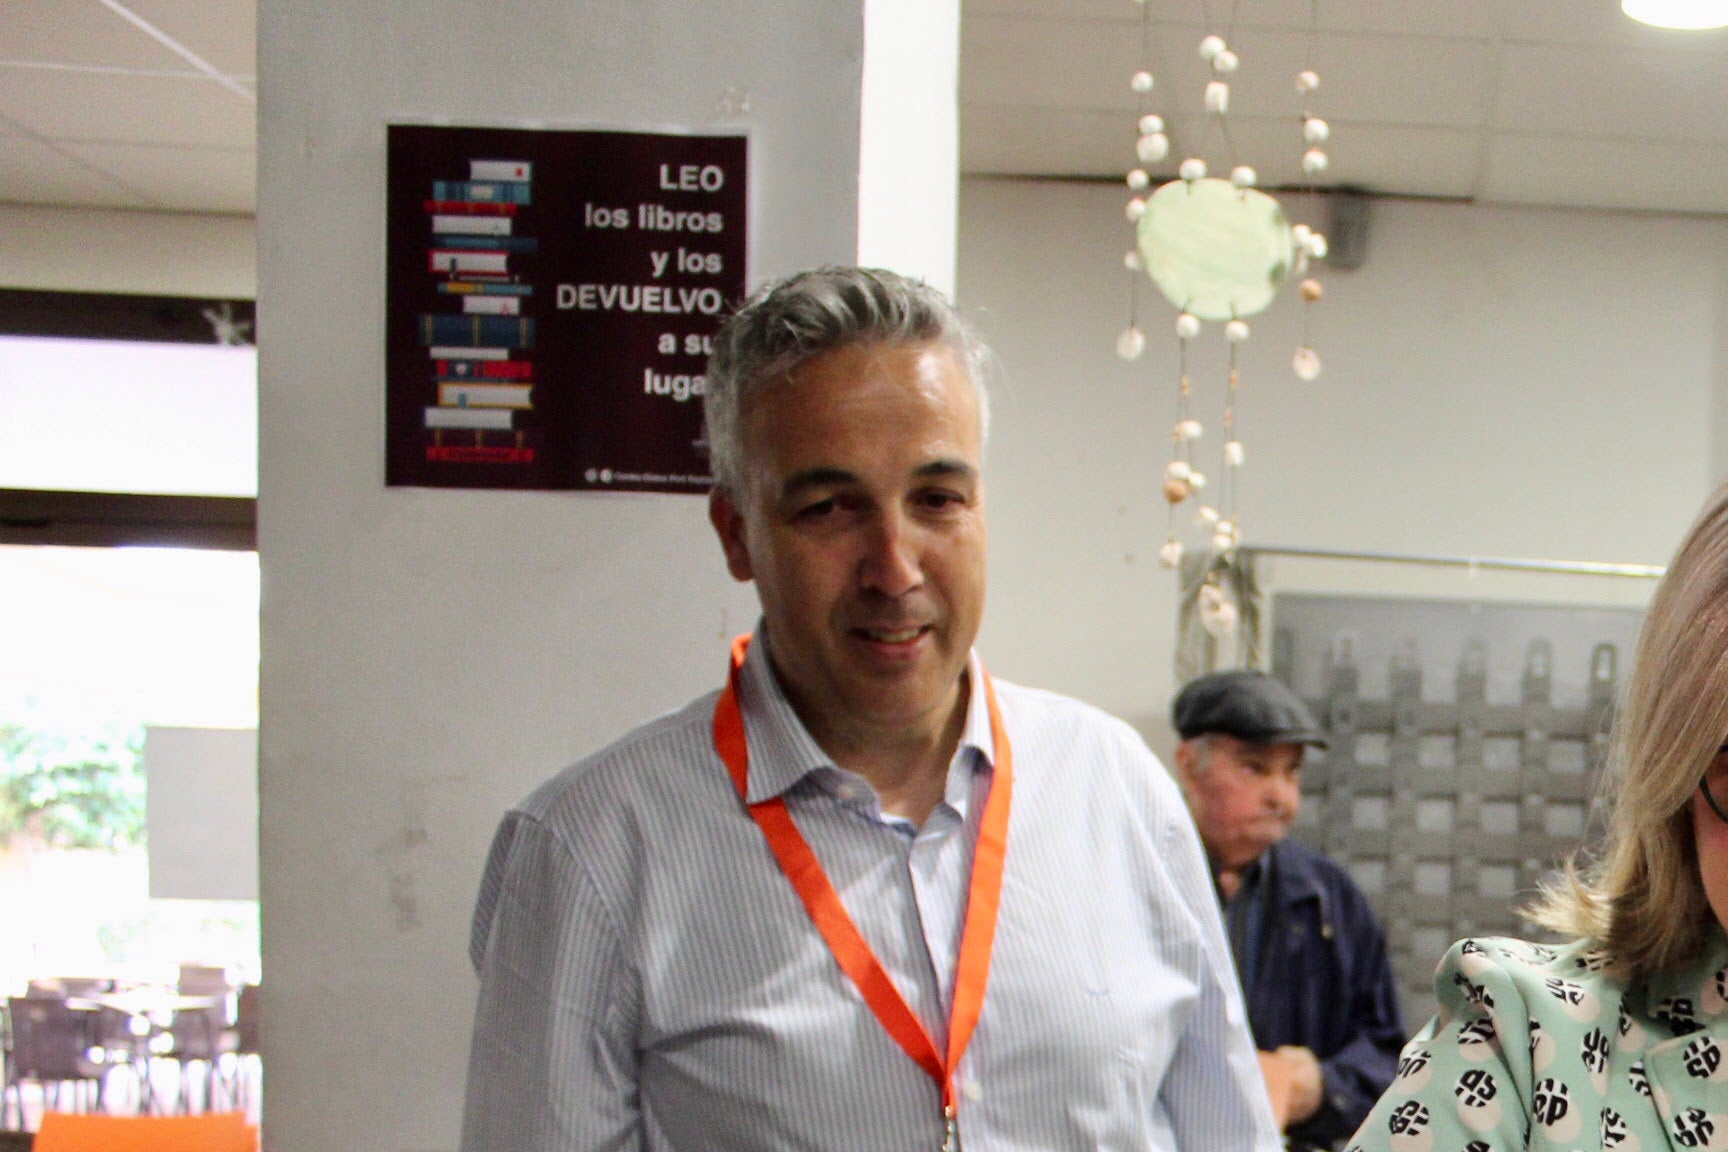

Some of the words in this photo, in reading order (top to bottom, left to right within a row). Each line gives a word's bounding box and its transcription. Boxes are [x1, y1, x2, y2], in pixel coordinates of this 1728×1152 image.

[660, 163, 725, 193] LEO
[585, 204, 630, 230] los
[638, 204, 723, 233] libros
[650, 251, 669, 277] y
[677, 248, 722, 274] los
[556, 284, 722, 314] DEVUELVO
[658, 333, 676, 354] a
[644, 367, 706, 402] luga
